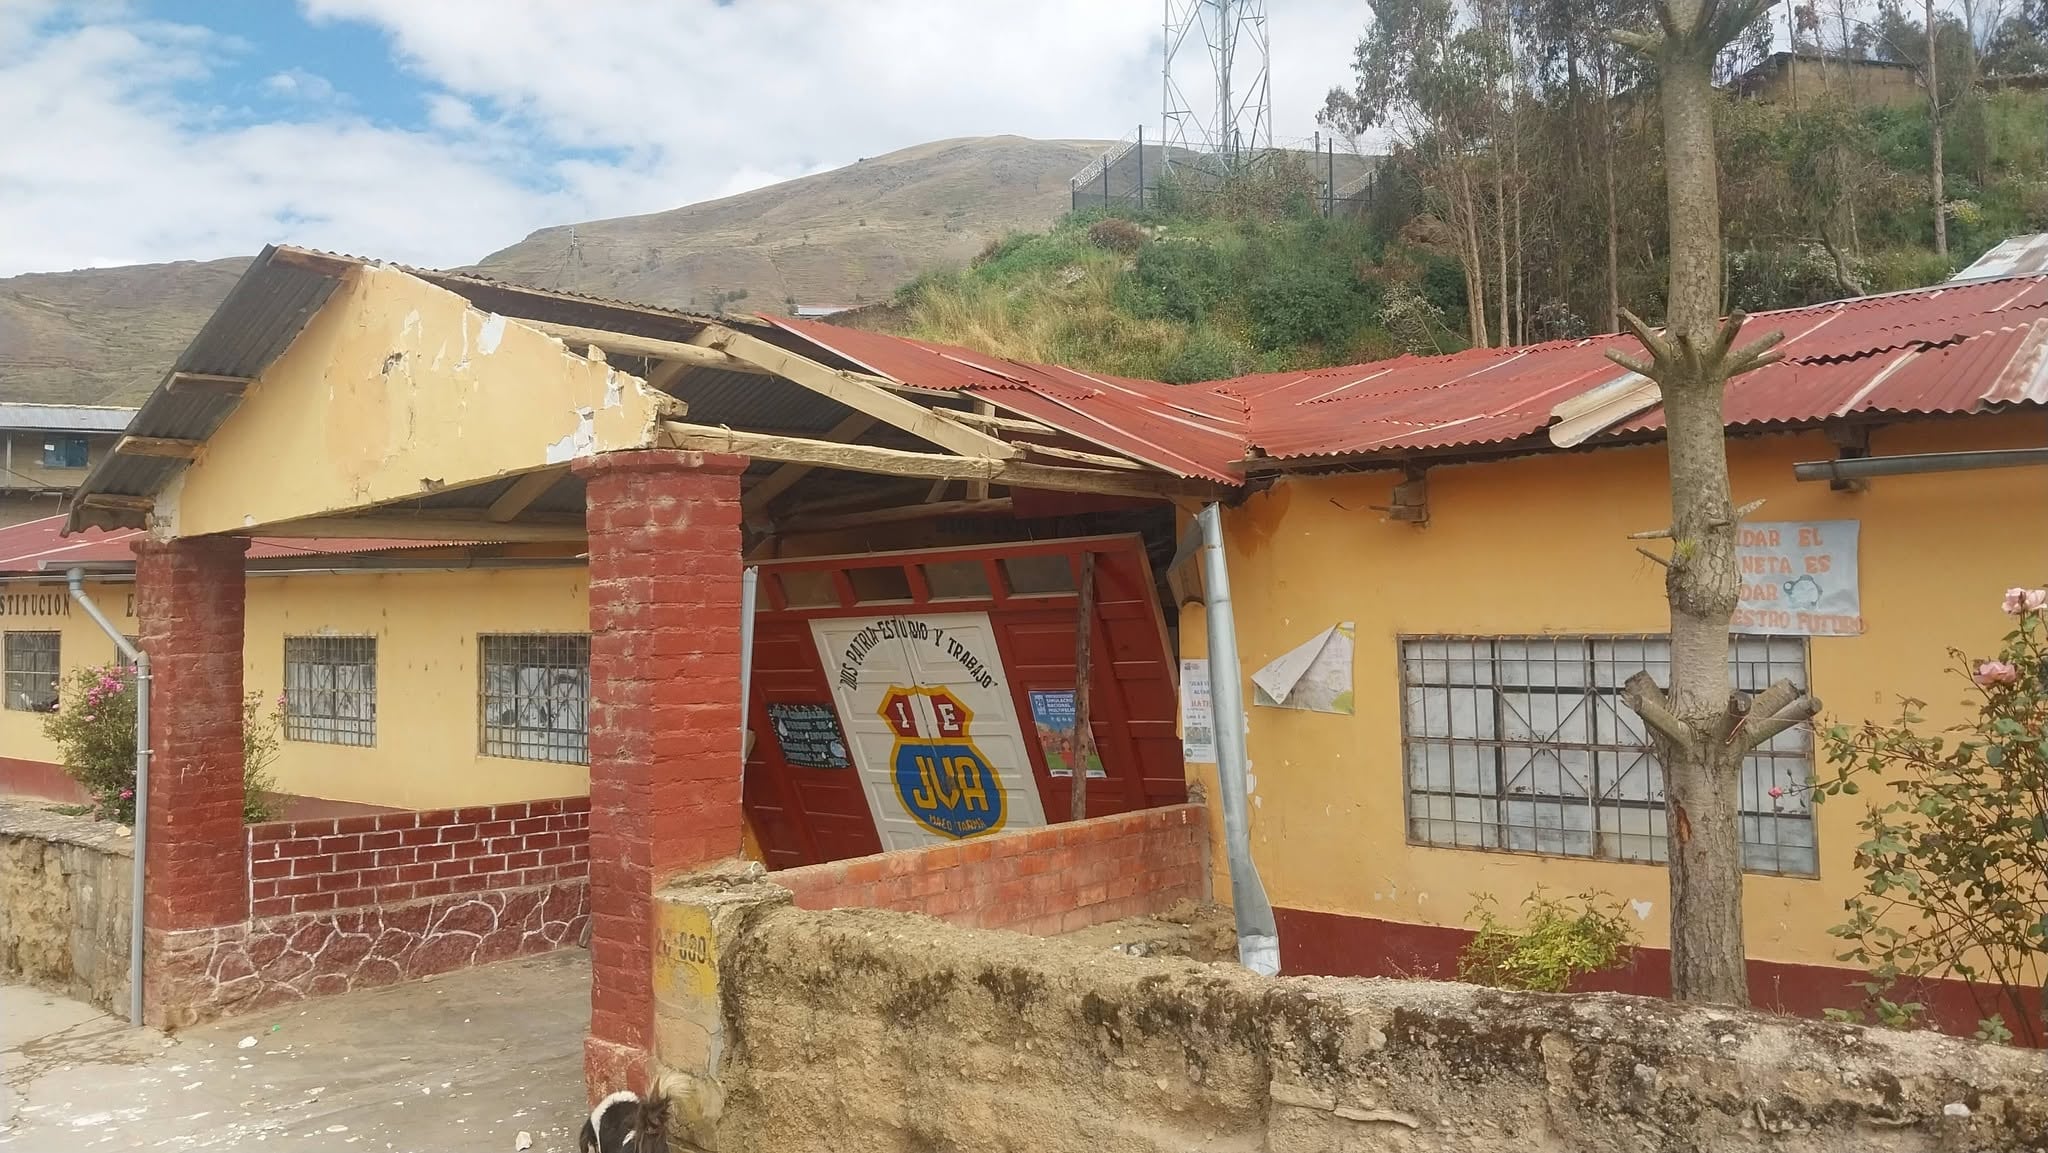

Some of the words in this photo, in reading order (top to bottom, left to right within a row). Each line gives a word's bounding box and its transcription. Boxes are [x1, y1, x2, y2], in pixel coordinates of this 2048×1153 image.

[1797, 527, 1823, 547] EL
[1741, 556, 1792, 574] NETA
[1804, 555, 1831, 574] ES
[1740, 583, 1777, 601] DAR
[0, 594, 71, 617] STITUCION
[1731, 608, 1790, 629] ESTRO
[1796, 611, 1866, 634] FUTURO
[934, 628, 943, 647] Y
[896, 702, 910, 729] I
[937, 703, 960, 731] E
[911, 755, 990, 812] JVA
